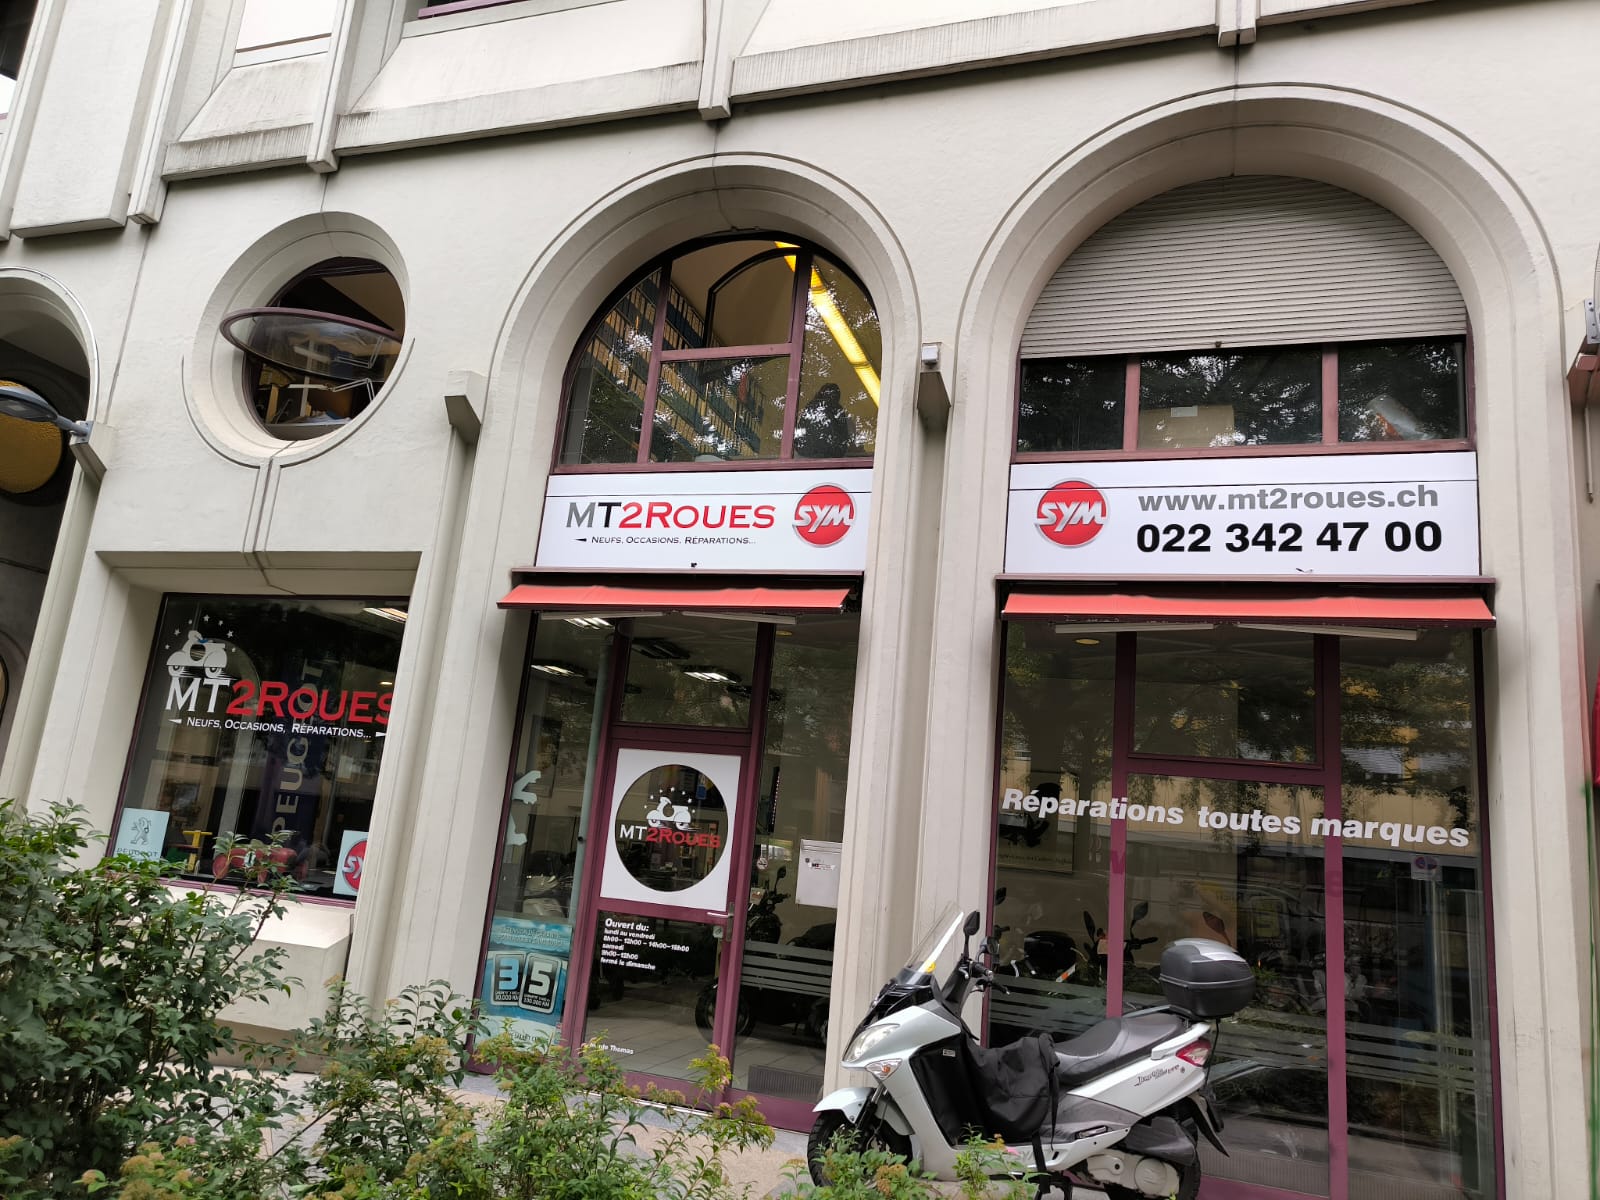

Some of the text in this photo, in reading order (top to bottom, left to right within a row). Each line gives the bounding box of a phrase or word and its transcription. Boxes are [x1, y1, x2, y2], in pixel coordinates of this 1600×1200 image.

[1138, 484, 1438, 512] www.mt2roues.ch
[566, 501, 776, 529] MT2ROUES
[793, 502, 852, 533] SYM
[1036, 500, 1107, 533] SYM
[1136, 521, 1442, 552] 022 342 47 00
[187, 716, 222, 728] NEUFS,
[224, 719, 286, 733] OCCASIONS,
[1002, 788, 1470, 847] Réparations toutes marques
[619, 824, 720, 848] MT2ROUES
[605, 918, 650, 932] Ouvert du:
[629, 932, 655, 940] vendredi
[602, 943, 624, 951] samedi
[499, 958, 552, 996] 3 5
[600, 957, 618, 965] fermé
[626, 961, 656, 970] dimanche
